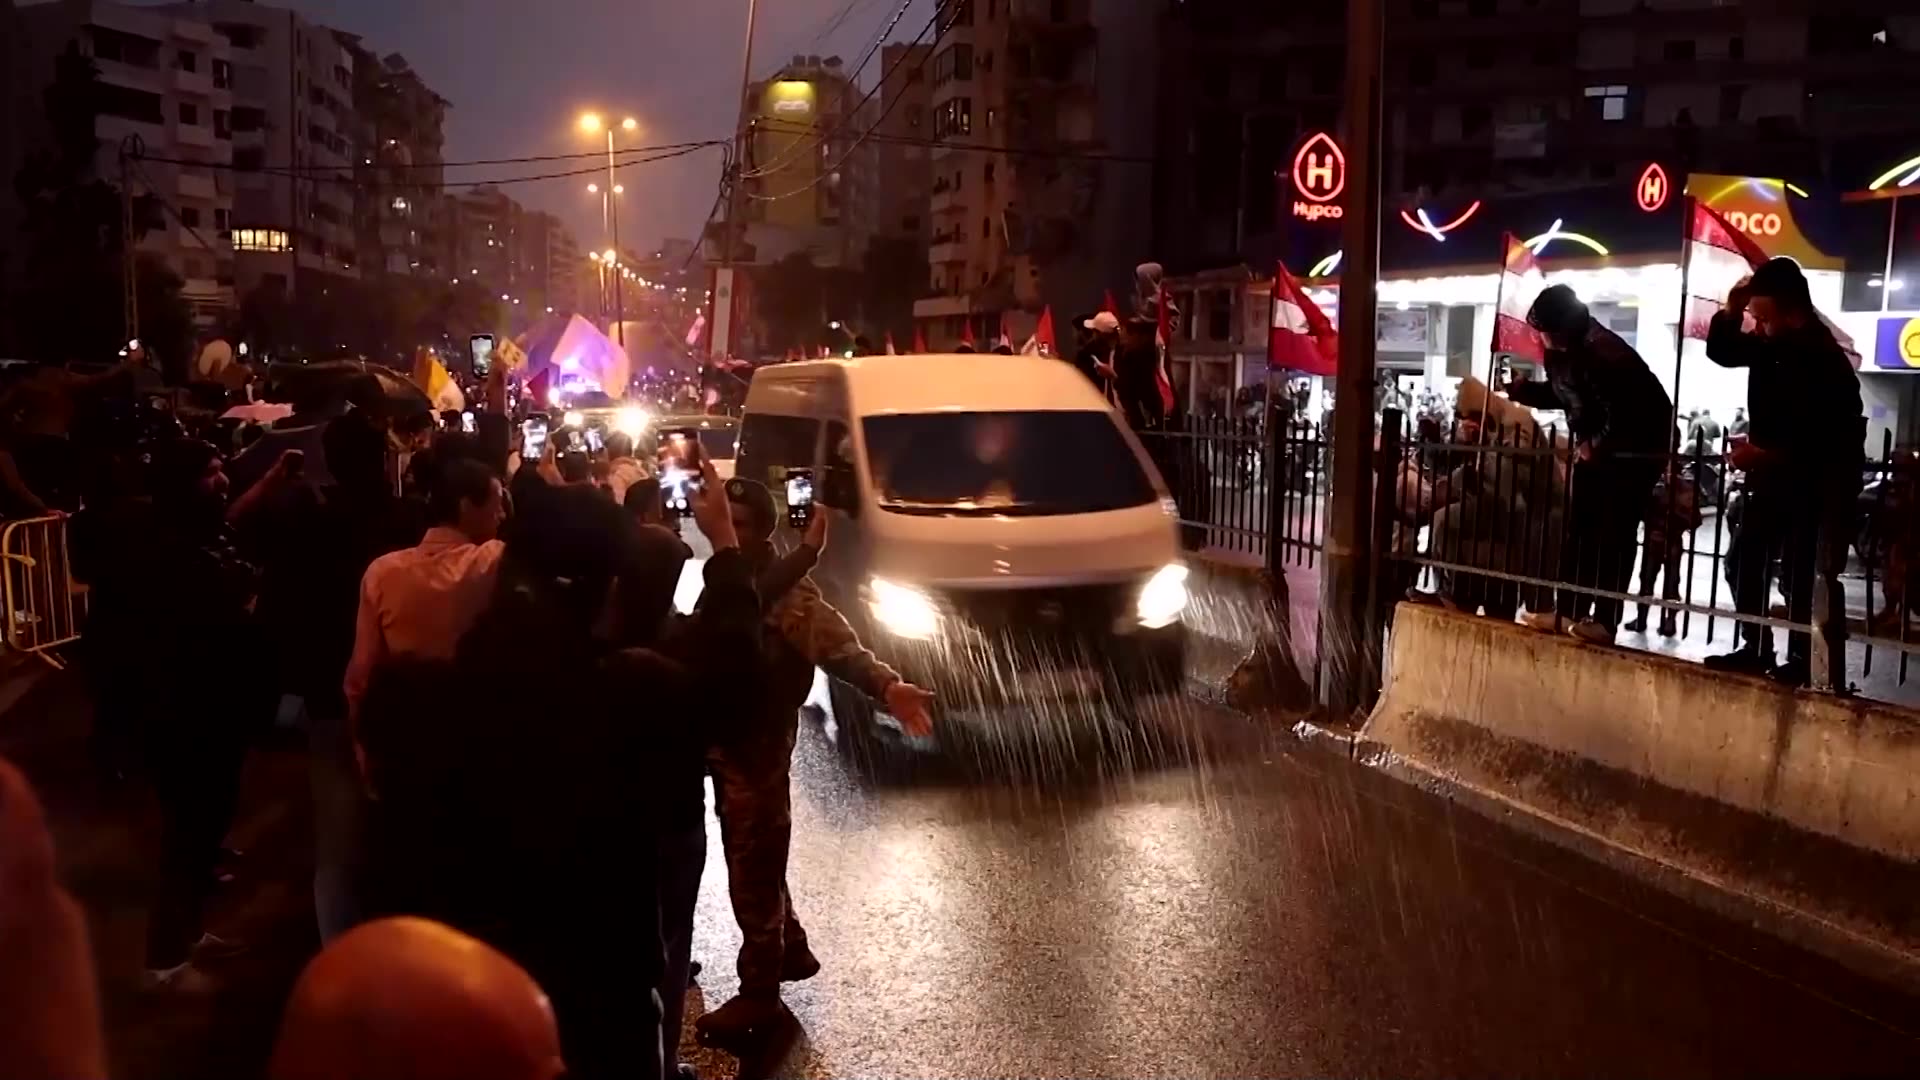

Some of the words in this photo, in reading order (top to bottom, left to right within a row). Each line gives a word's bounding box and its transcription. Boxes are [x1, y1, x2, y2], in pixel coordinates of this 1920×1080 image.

[1307, 152, 1333, 190] H
[1643, 176, 1661, 204] H
[1293, 201, 1343, 221] Hypco
